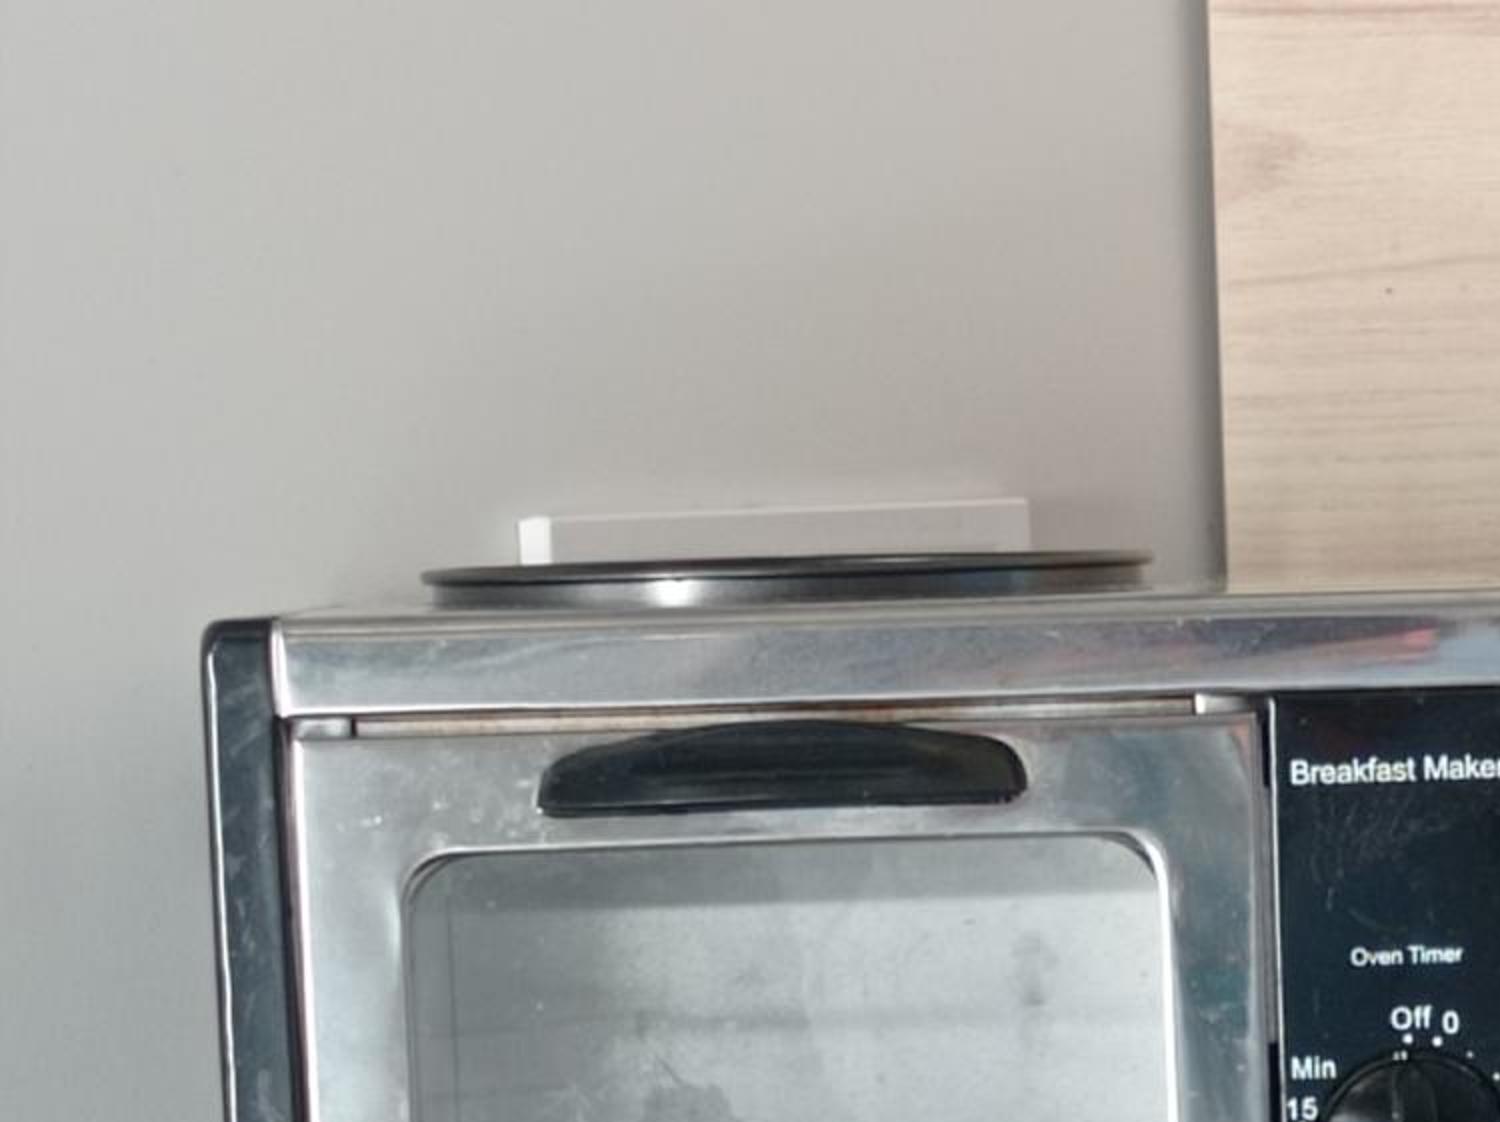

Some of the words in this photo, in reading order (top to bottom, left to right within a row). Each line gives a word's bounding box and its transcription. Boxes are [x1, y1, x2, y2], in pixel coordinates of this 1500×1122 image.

[1290, 756, 1417, 786] Breakfast
[1350, 946, 1404, 967] Oven
[1407, 944, 1463, 965] Timer
[1390, 1004, 1433, 1031] Off
[1441, 1010, 1460, 1035] 0
[1290, 1055, 1337, 1080] Min
[1285, 1096, 1319, 1121] 15
